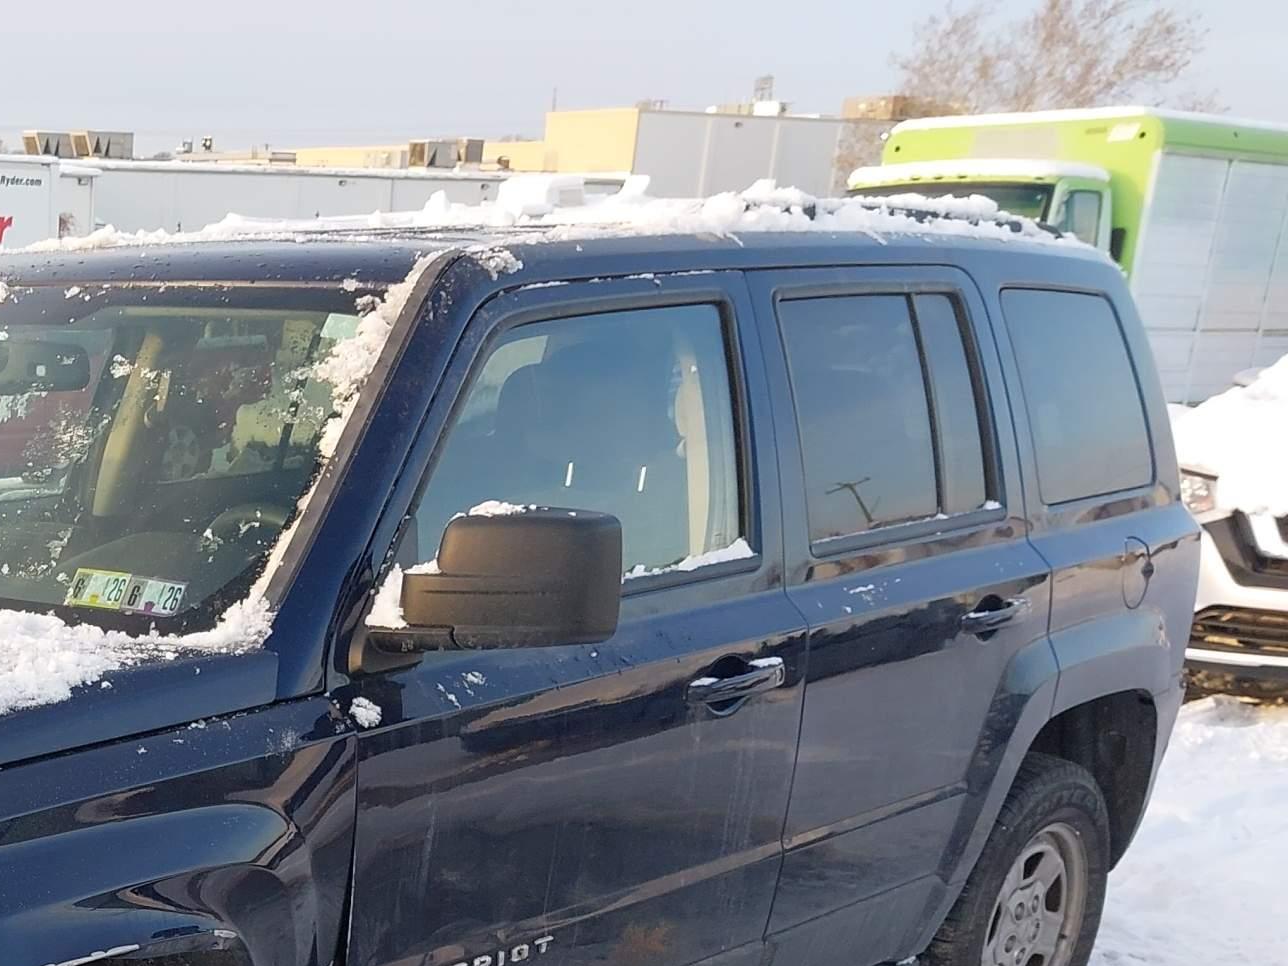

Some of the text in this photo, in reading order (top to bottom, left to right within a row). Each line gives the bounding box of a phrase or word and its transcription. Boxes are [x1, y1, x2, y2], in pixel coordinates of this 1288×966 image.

[0, 175, 42, 187] Ryder.com
[73, 578, 85, 599] 6
[127, 585, 141, 607] 6
